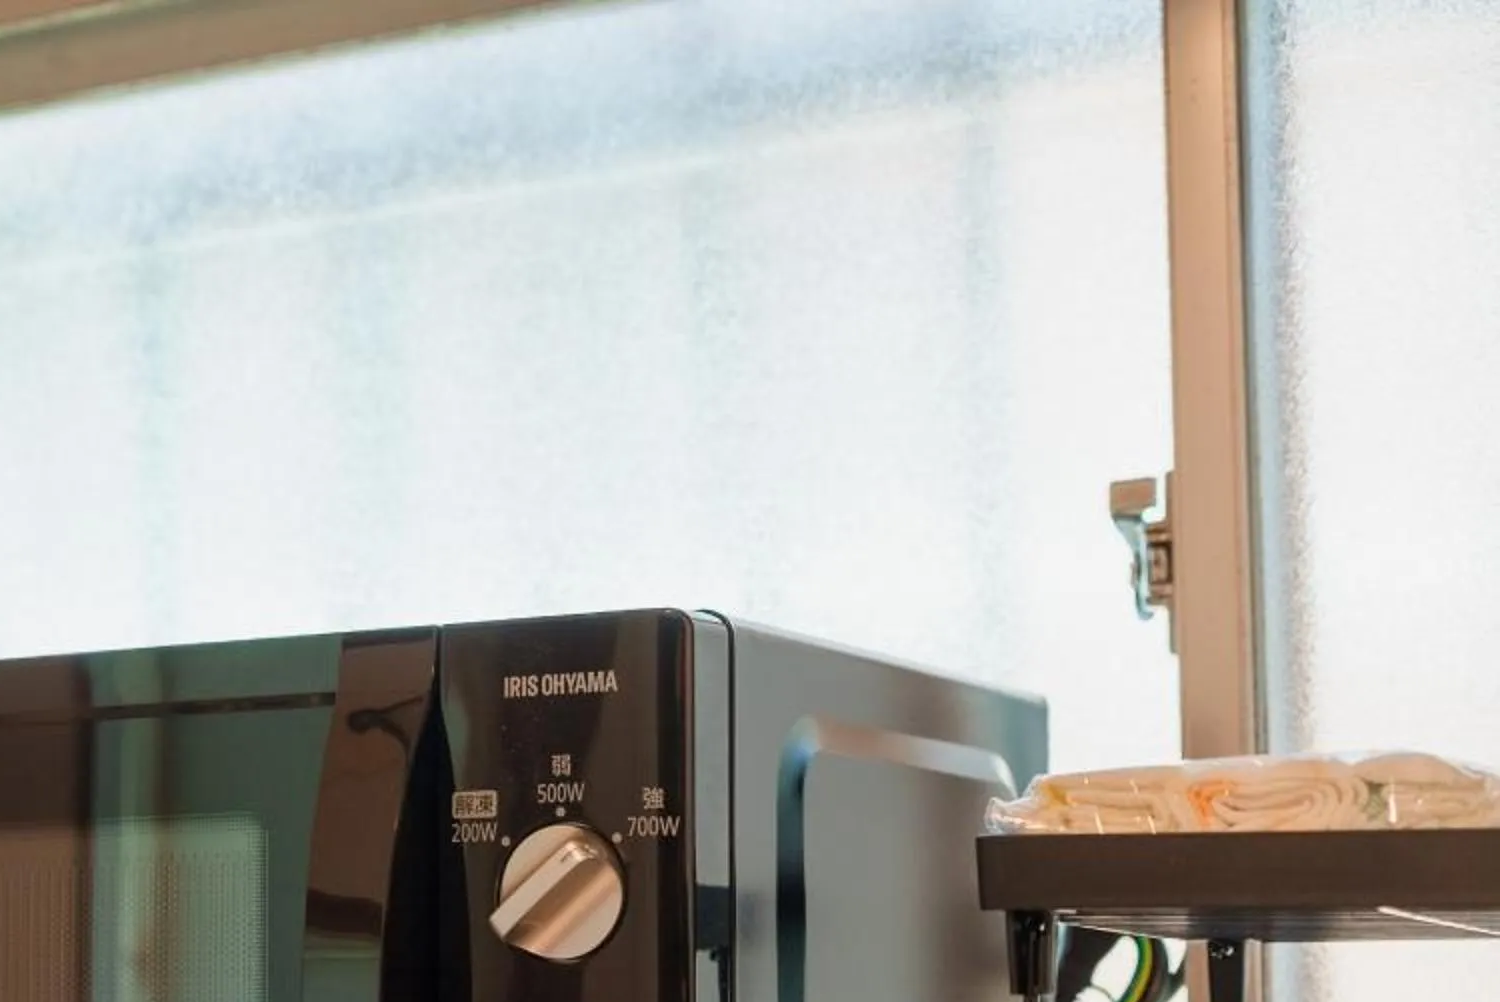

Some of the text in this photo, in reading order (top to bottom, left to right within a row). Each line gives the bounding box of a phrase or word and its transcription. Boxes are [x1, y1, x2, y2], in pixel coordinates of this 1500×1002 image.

[503, 670, 619, 698] IRIS OHYAMA
[537, 783, 585, 804] 500W
[643, 787, 664, 810] 強
[451, 823, 497, 843] 200W
[627, 816, 681, 837] 700W
